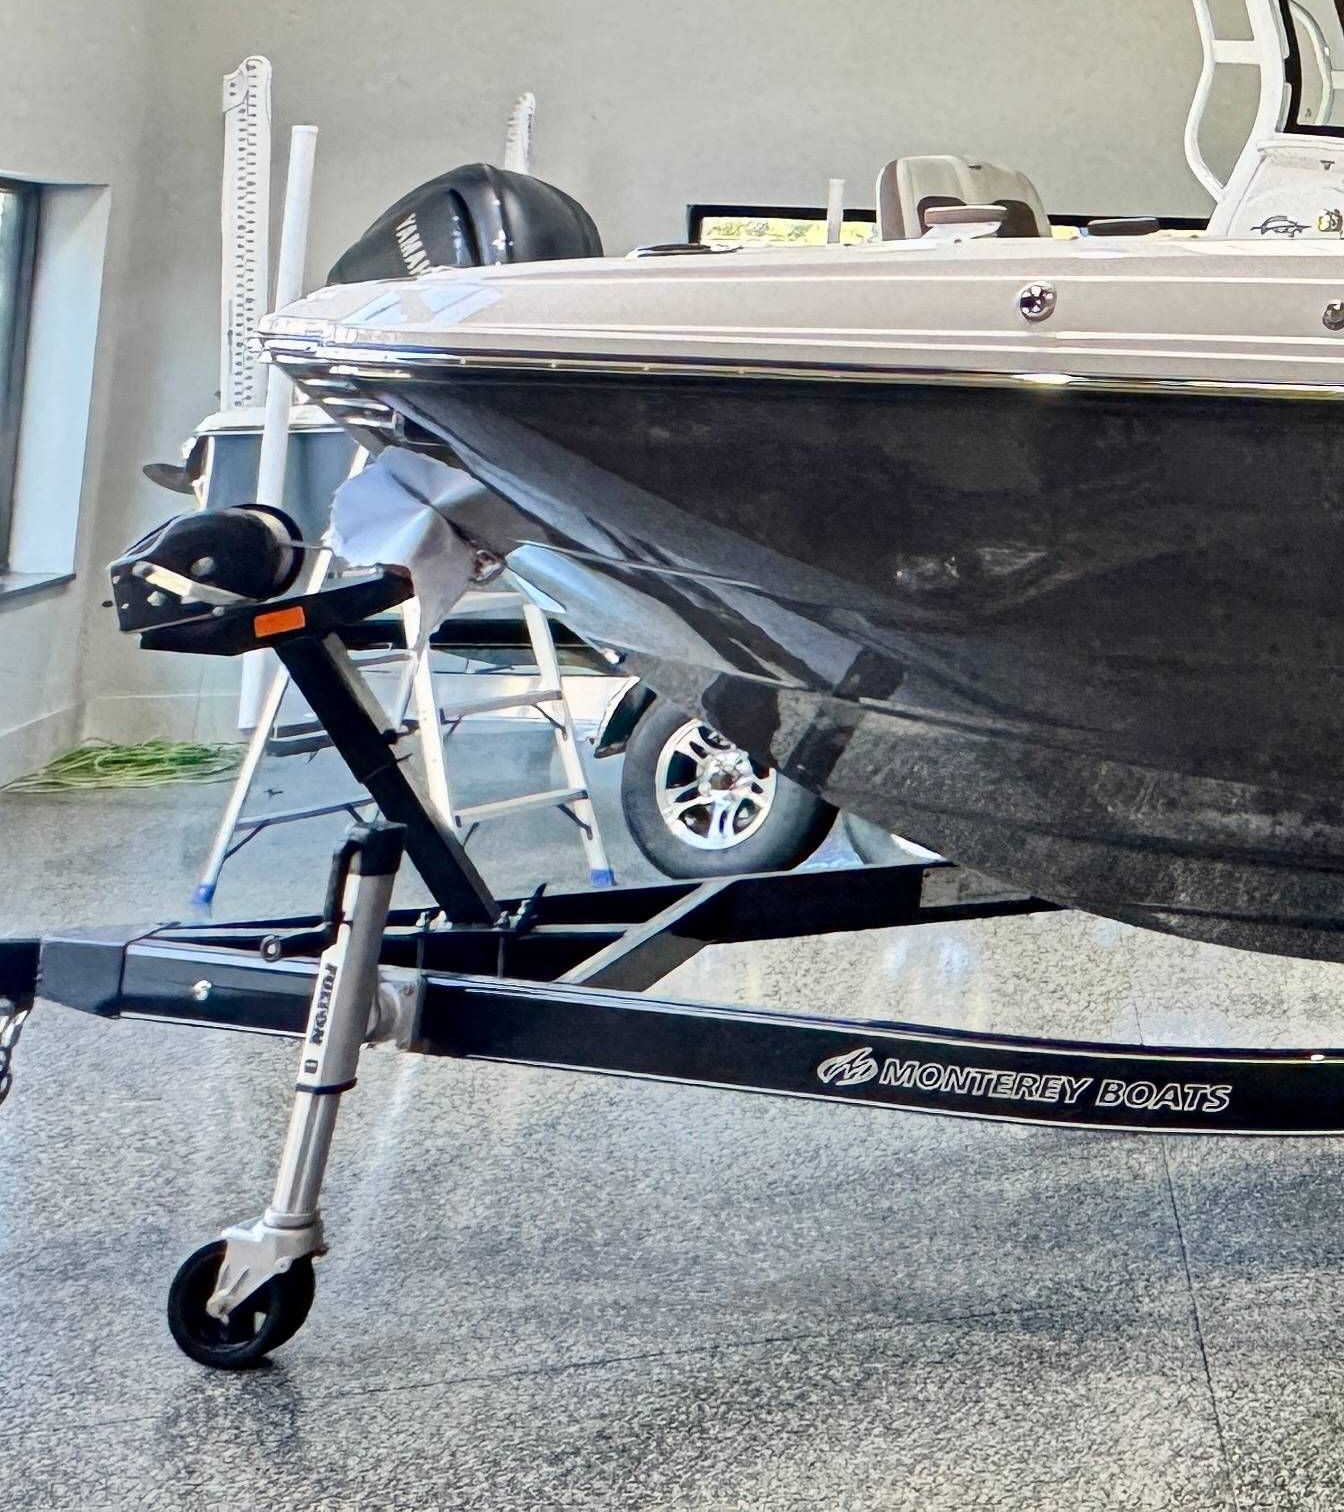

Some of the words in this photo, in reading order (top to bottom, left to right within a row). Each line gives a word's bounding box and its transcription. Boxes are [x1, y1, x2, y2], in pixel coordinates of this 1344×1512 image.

[395, 212, 433, 276] YAMAH
[309, 963, 338, 1044] FULTON
[877, 1058, 1093, 1104] MONTEREY
[1095, 1079, 1232, 1113] BOATS
